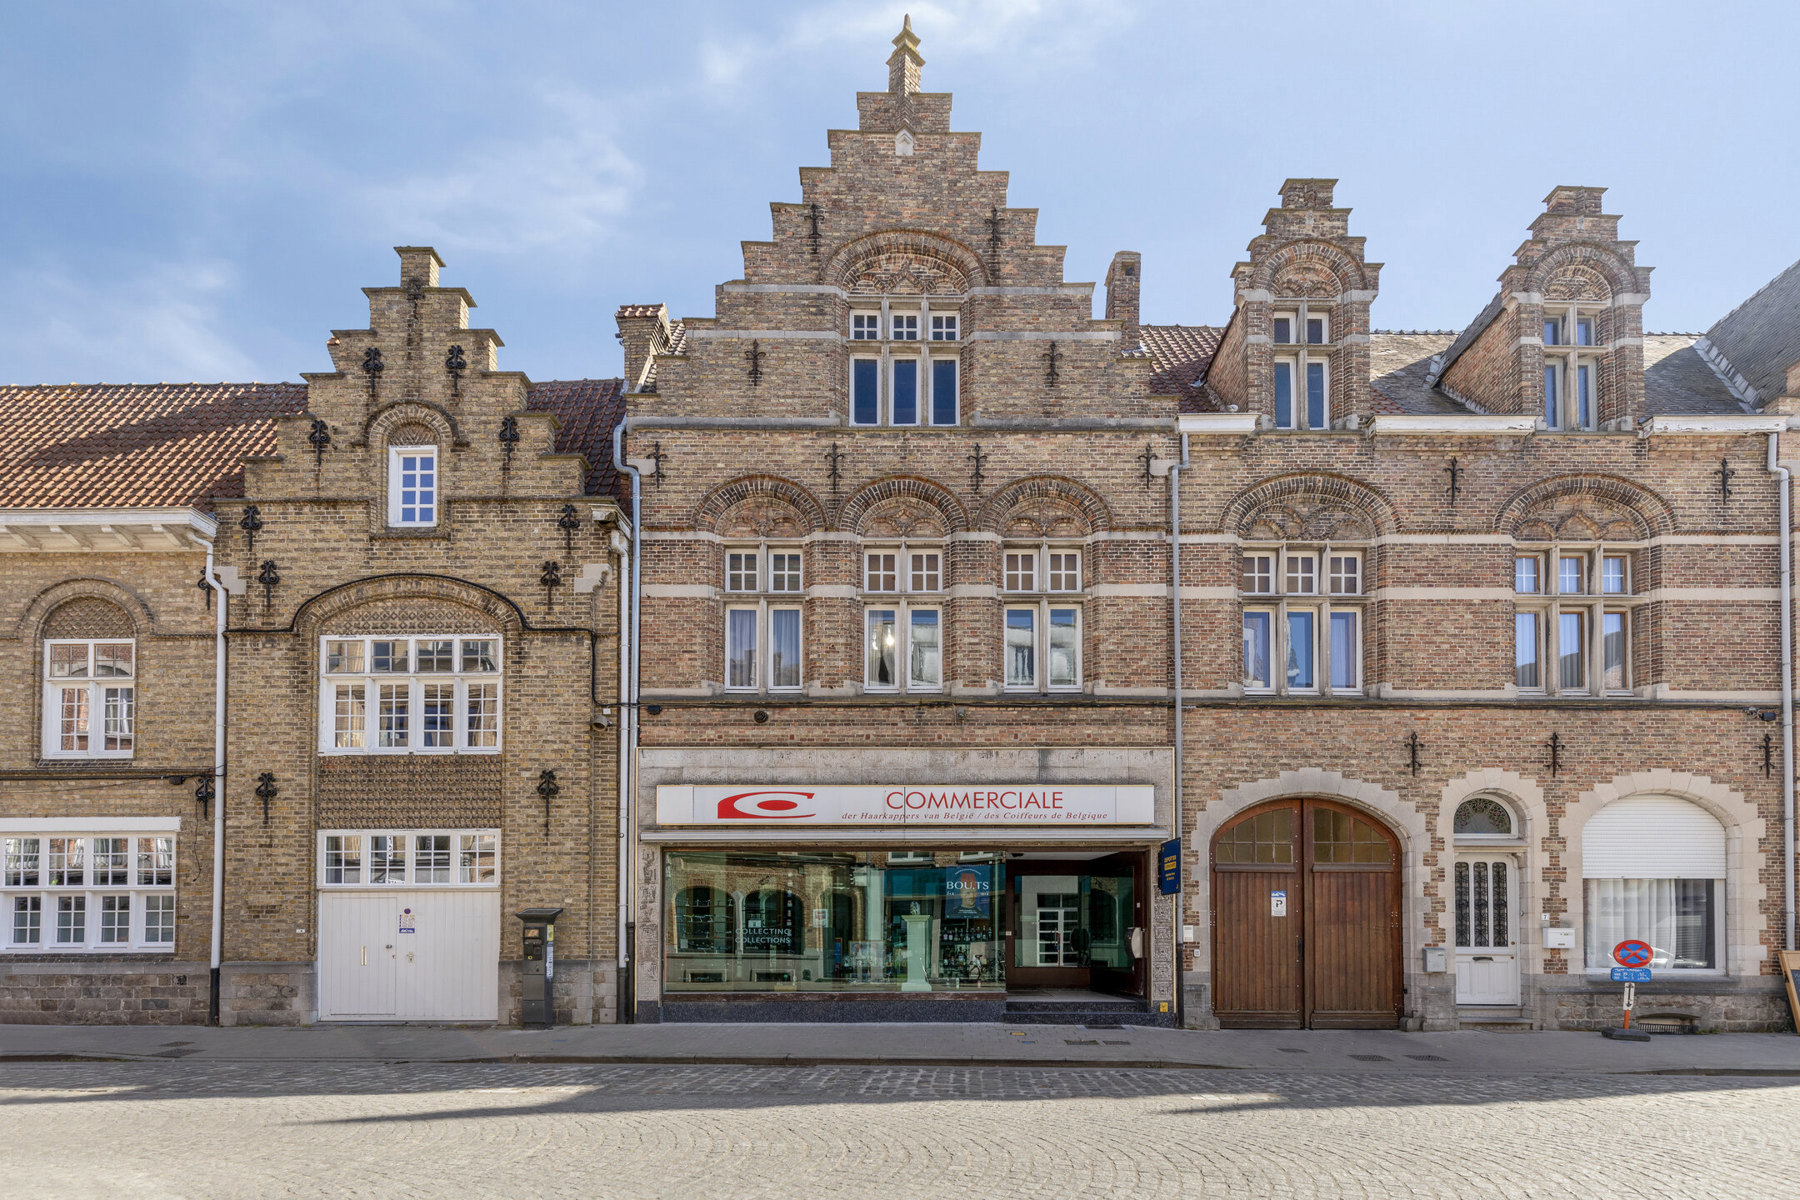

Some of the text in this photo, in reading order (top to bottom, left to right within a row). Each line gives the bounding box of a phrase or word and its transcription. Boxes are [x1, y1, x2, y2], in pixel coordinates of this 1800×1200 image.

[886, 791, 1063, 809] COMMERCIALE
[860, 812, 920, 821] Haarkappers
[943, 812, 974, 821] België
[1066, 812, 1108, 821] Belgique
